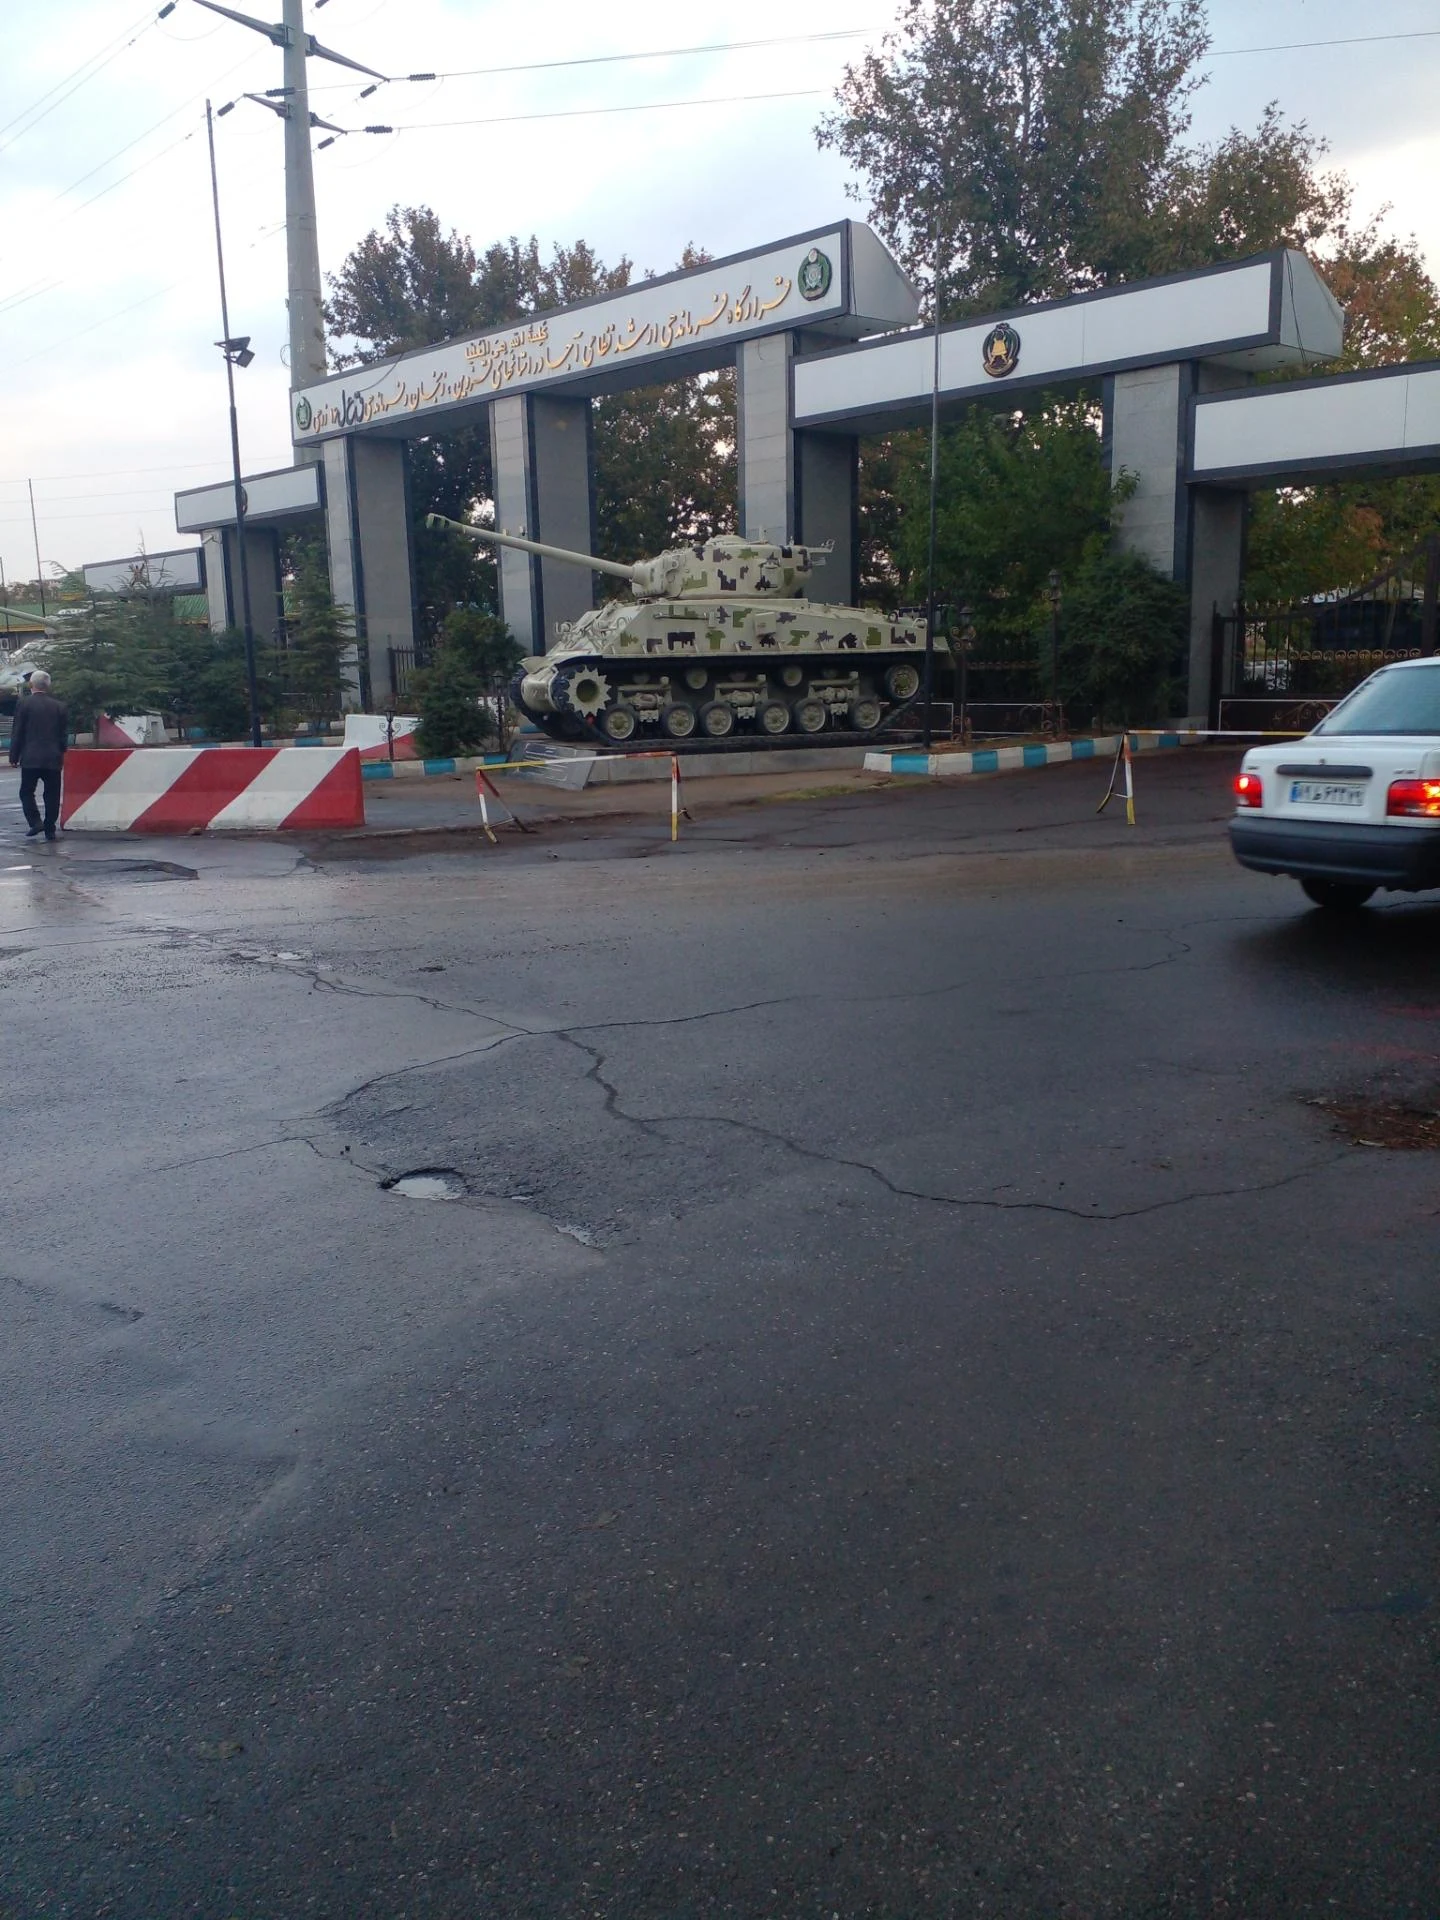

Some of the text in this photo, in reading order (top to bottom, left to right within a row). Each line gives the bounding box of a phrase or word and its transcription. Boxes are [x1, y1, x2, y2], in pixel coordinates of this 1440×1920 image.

[660, 292, 728, 349] فرماندهی
[727, 274, 792, 324] قرارگاه
[614, 317, 659, 353] ارشد
